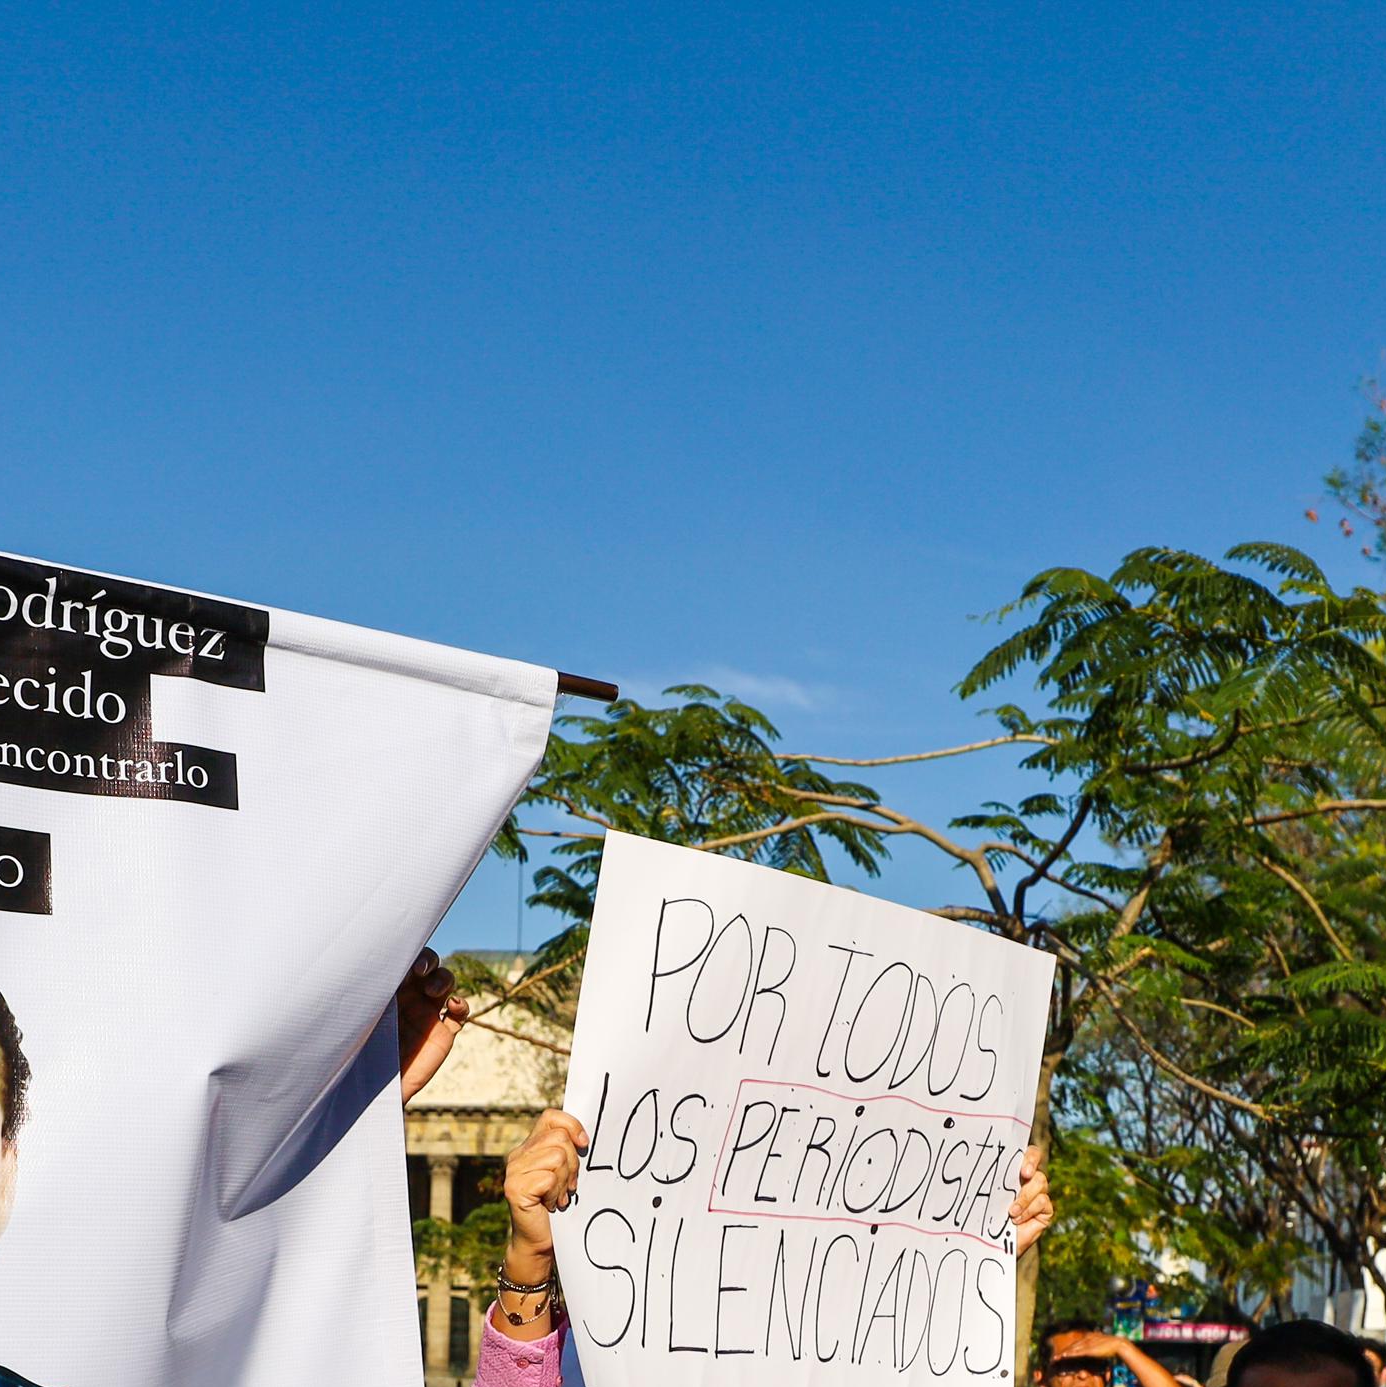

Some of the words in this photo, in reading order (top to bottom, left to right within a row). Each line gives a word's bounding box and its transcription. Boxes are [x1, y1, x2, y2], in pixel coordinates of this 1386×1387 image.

[646, 898, 795, 1066] POR
[816, 944, 1003, 1101] TODOS
[587, 1073, 705, 1184] LOS
